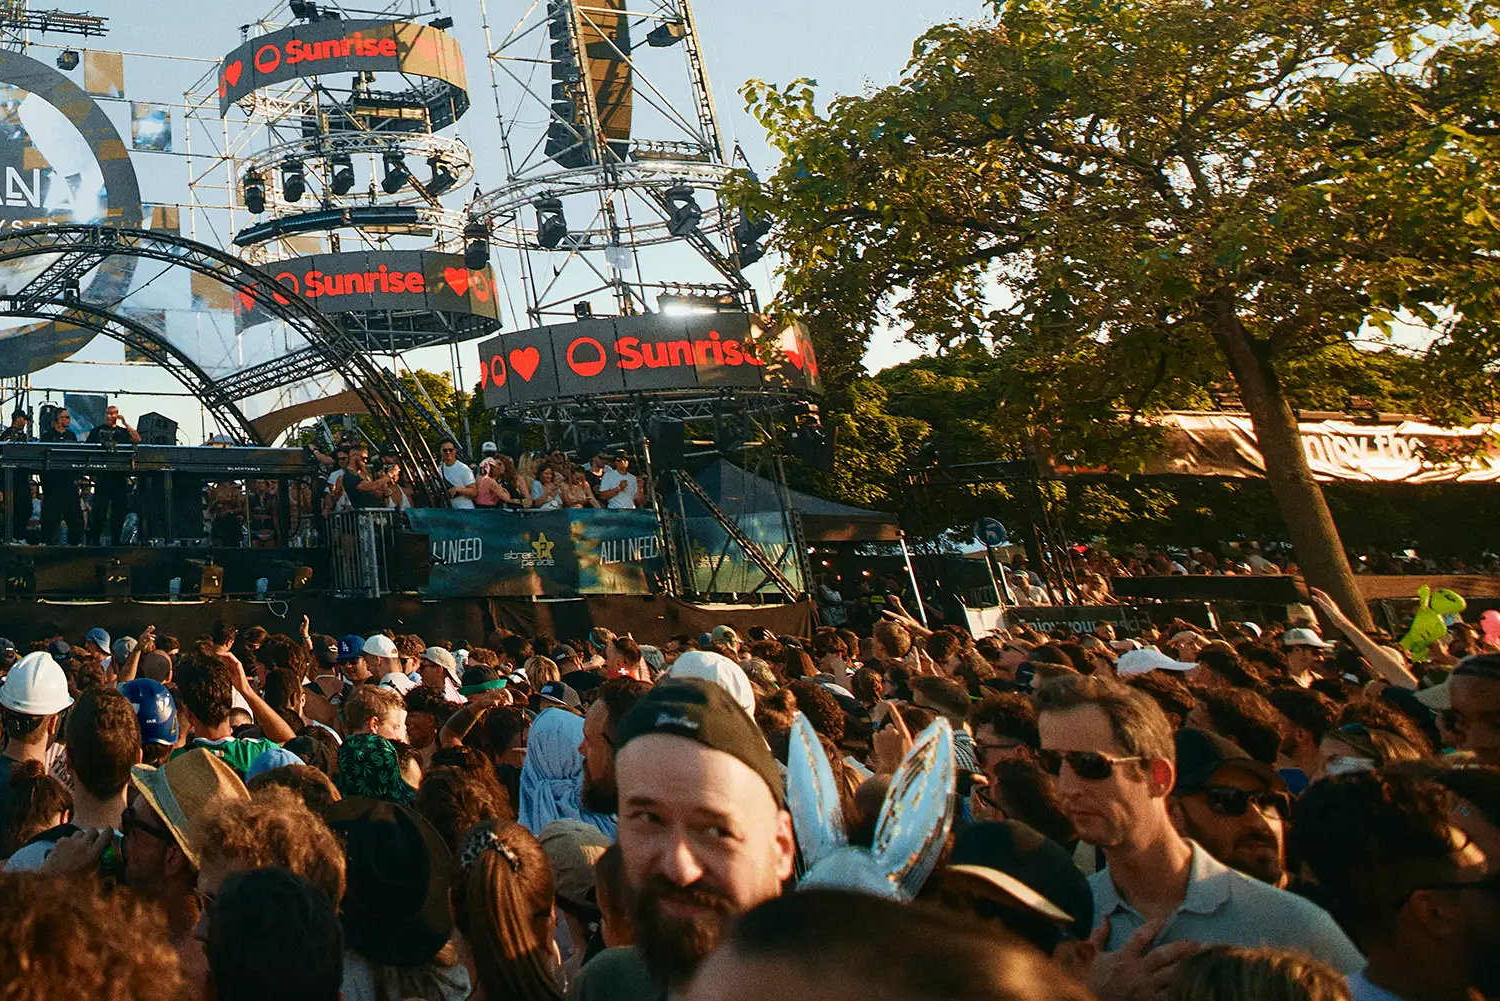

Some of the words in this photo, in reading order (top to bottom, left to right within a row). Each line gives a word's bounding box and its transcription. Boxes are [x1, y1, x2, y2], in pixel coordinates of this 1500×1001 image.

[285, 32, 397, 65] Sunrise
[304, 265, 425, 298] Sunrise
[448, 537, 482, 564] NEED
[503, 549, 537, 560] street
[600, 539, 620, 565] ALL
[628, 536, 658, 562] NEED
